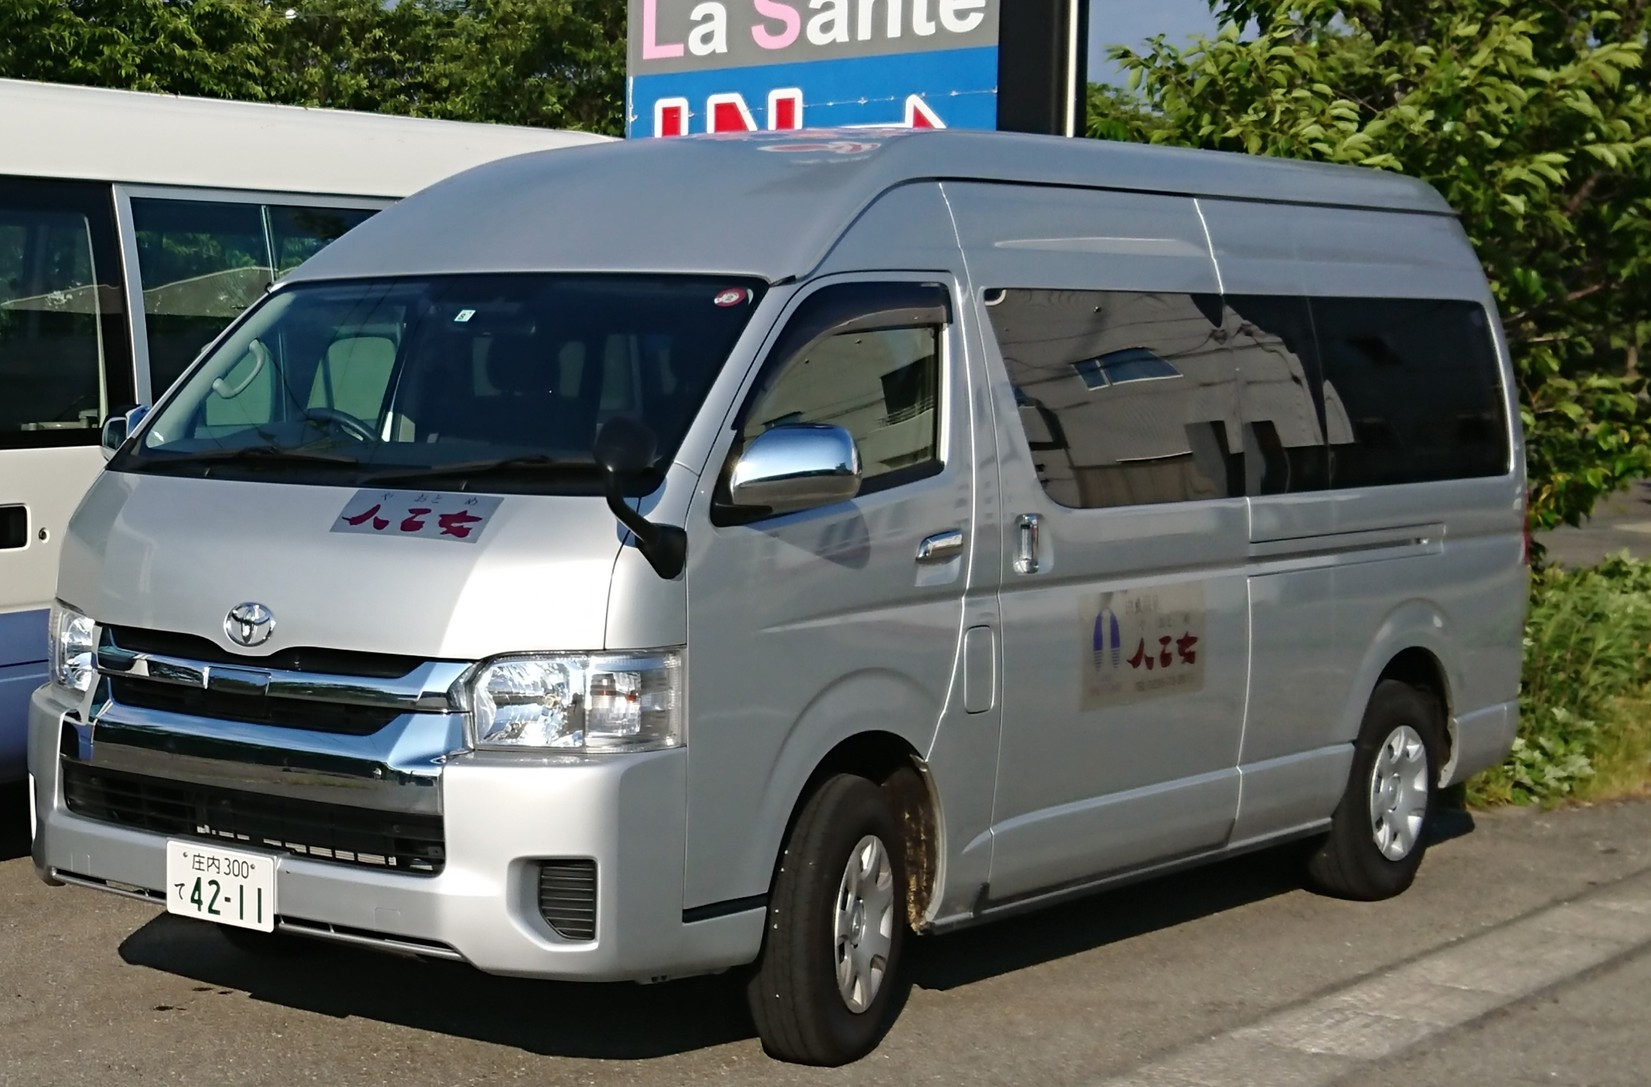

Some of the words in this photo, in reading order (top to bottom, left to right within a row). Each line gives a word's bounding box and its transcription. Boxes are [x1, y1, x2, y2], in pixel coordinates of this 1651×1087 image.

[642, 0, 729, 60] La
[341, 504, 483, 539] 八乙女
[174, 882, 186, 900] て
[190, 876, 262, 924] 42-11
